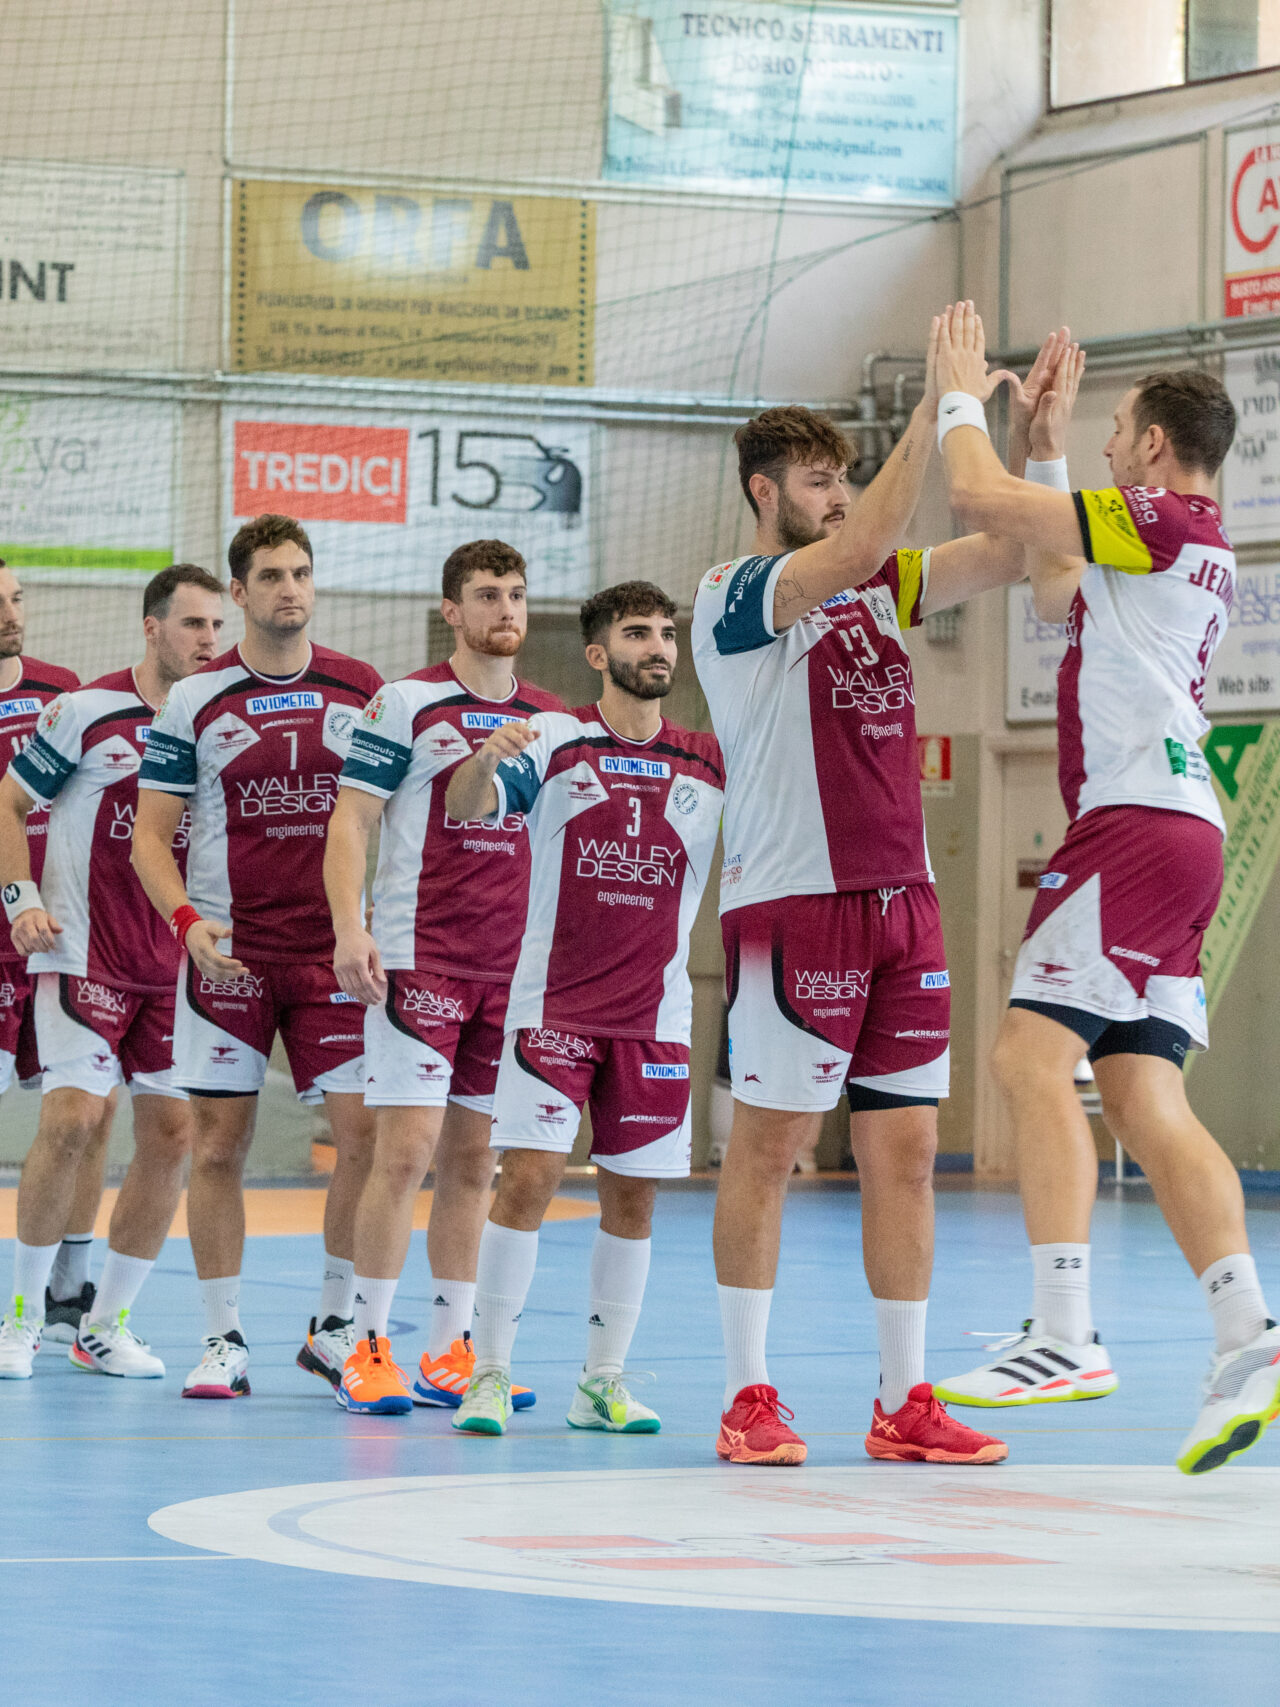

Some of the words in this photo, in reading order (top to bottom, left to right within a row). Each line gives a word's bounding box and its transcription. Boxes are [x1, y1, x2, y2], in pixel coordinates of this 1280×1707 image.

[300, 190, 531, 271] ORFA
[241, 450, 403, 497] TREDICI
[827, 662, 912, 691] WALLEY
[1218, 674, 1246, 695] Web
[252, 693, 318, 714] AVIOMETAL
[832, 686, 916, 714] DESIGN
[283, 731, 299, 771] 1
[605, 757, 666, 777] AVIOMETAL
[236, 774, 340, 797] WALLEY
[240, 795, 338, 818] DESIGN
[625, 795, 642, 838] 3
[266, 824, 325, 841] engineering
[463, 838, 516, 856] engineering
[577, 837, 682, 868] WALLEY
[576, 857, 677, 887] DESIGN
[597, 890, 655, 910] engineering
[795, 969, 870, 985] WALLEY
[200, 981, 263, 999] DESIGN
[404, 988, 463, 1010] WALLEY
[795, 983, 869, 1001] DESIGN
[403, 999, 464, 1022] DESIGN
[813, 1006, 851, 1019] engineering
[529, 1028, 594, 1053] WALLEY
[645, 1065, 688, 1078] AVIOMETAL
